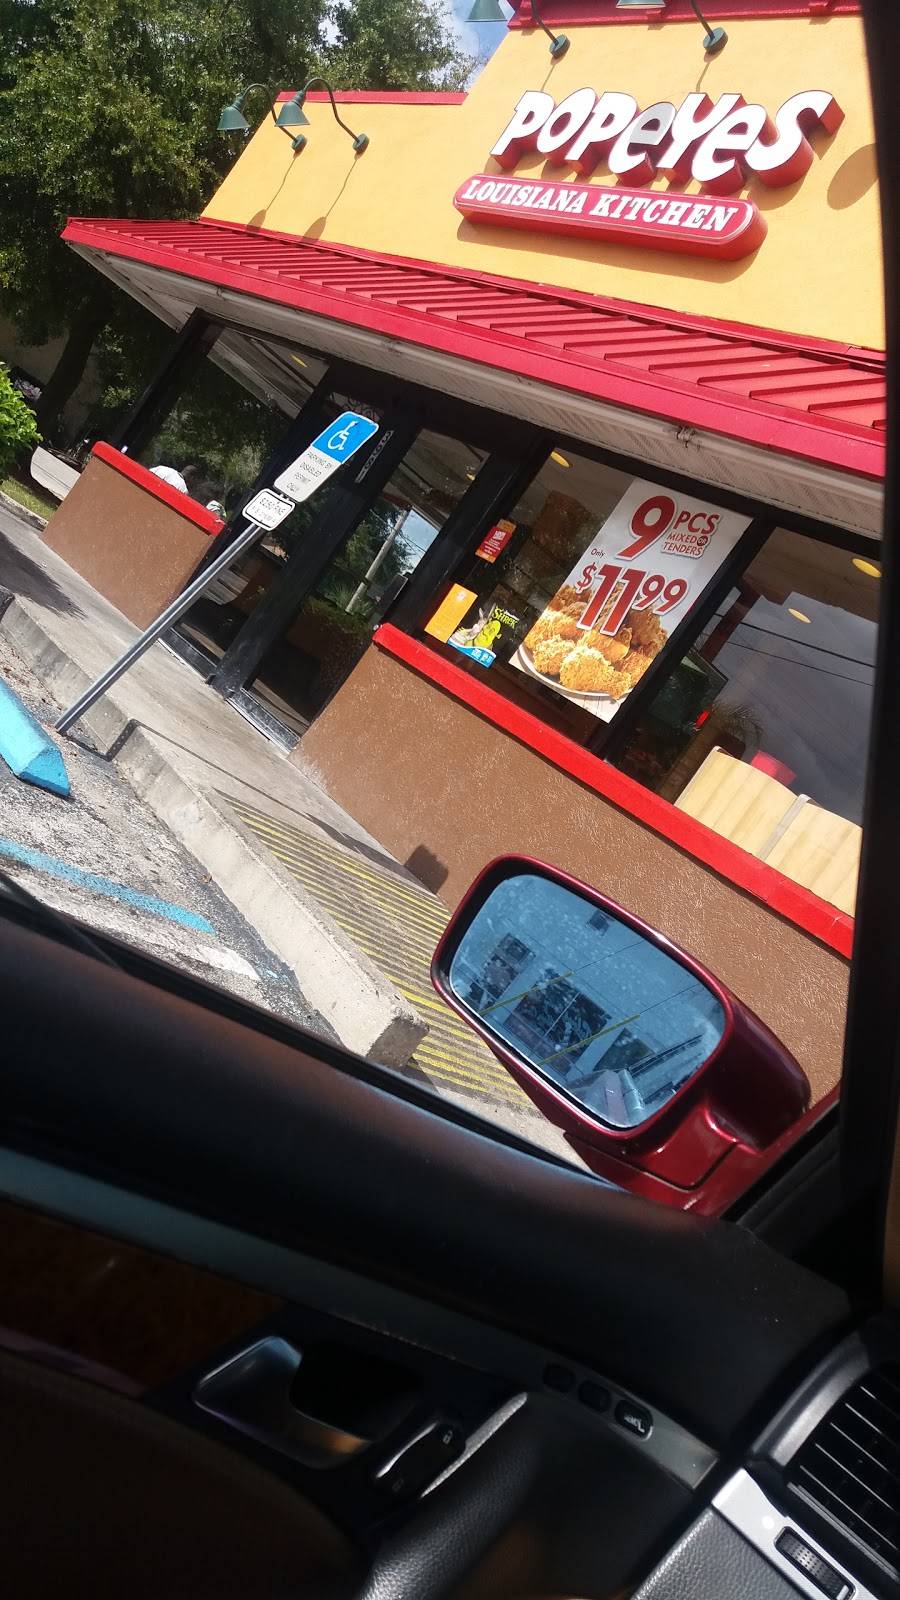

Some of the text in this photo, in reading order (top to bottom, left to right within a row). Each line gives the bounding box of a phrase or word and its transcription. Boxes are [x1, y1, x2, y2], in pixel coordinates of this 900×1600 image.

[461, 178, 739, 233] LOUISIANA KITCHEN
[617, 495, 720, 558] 9 PCS
[666, 531, 698, 544] MIXED
[590, 547, 606, 560] Only
[662, 541, 704, 557] TENDERS
